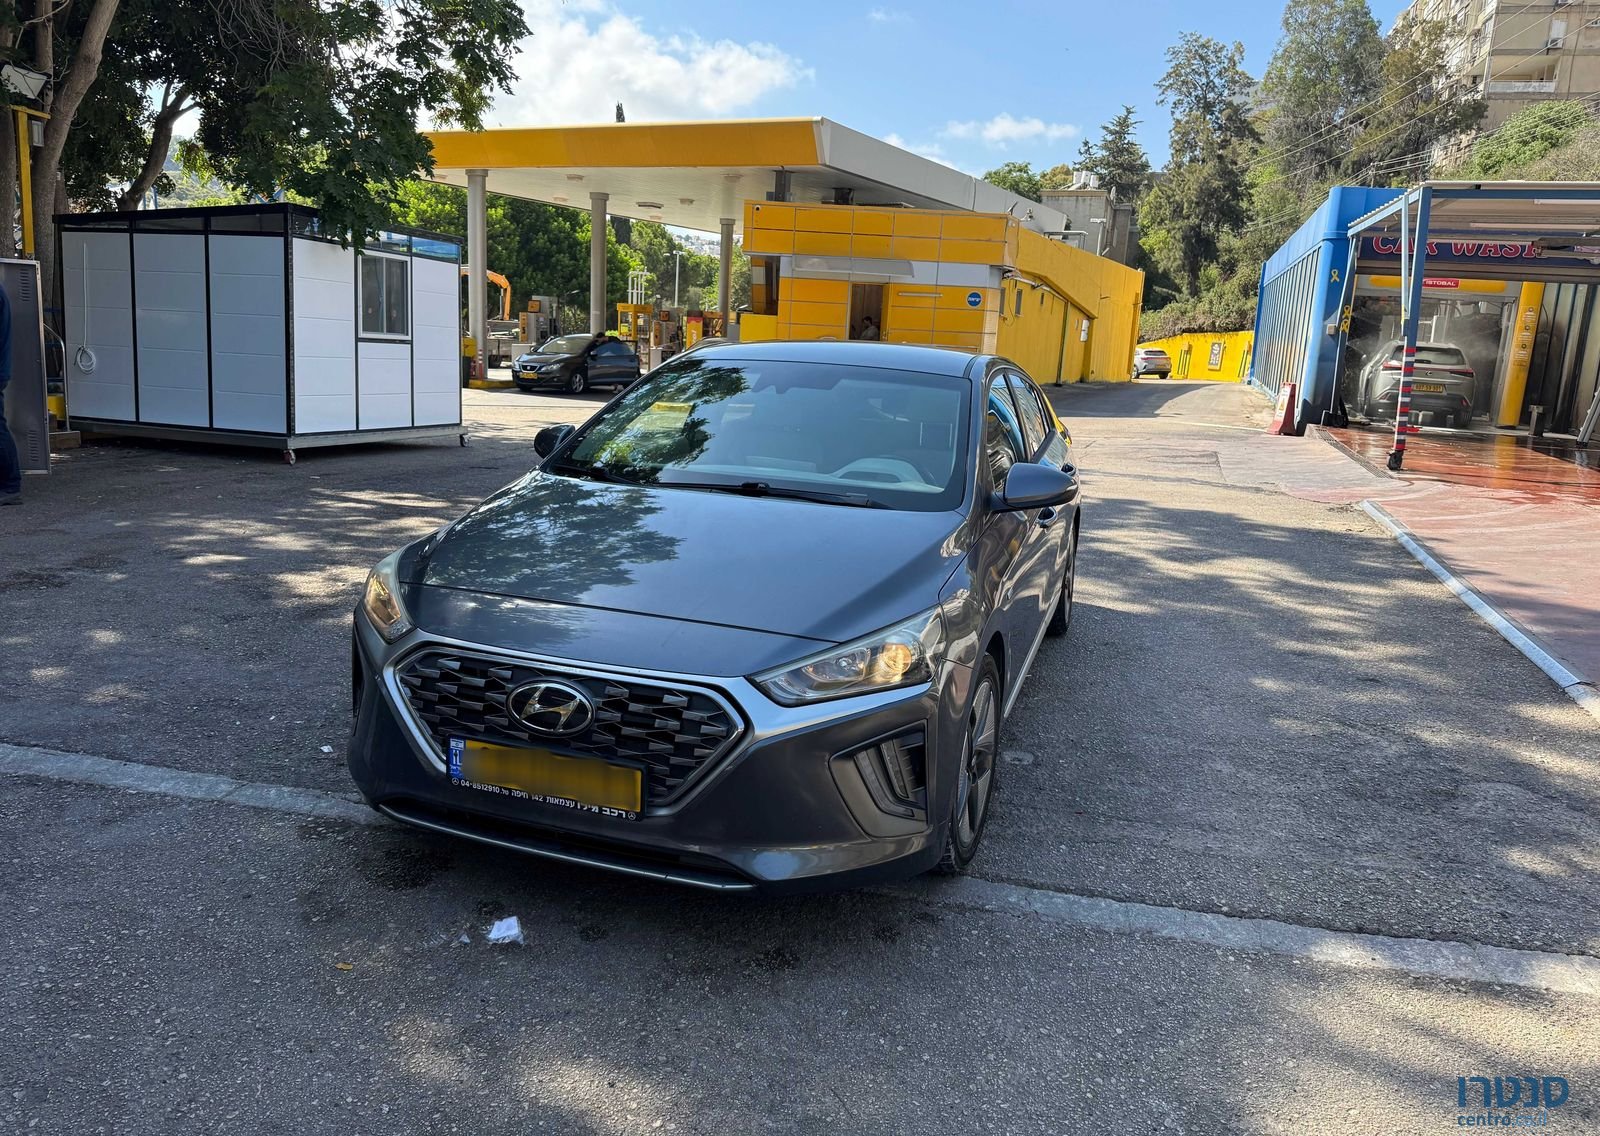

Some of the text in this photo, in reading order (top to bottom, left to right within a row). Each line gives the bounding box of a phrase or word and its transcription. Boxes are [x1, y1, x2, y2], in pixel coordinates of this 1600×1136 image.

[453, 750, 463, 765] IL
[511, 790, 529, 799] חיפה
[546, 796, 575, 808] עצמאות
[602, 807, 626, 819] רכב
